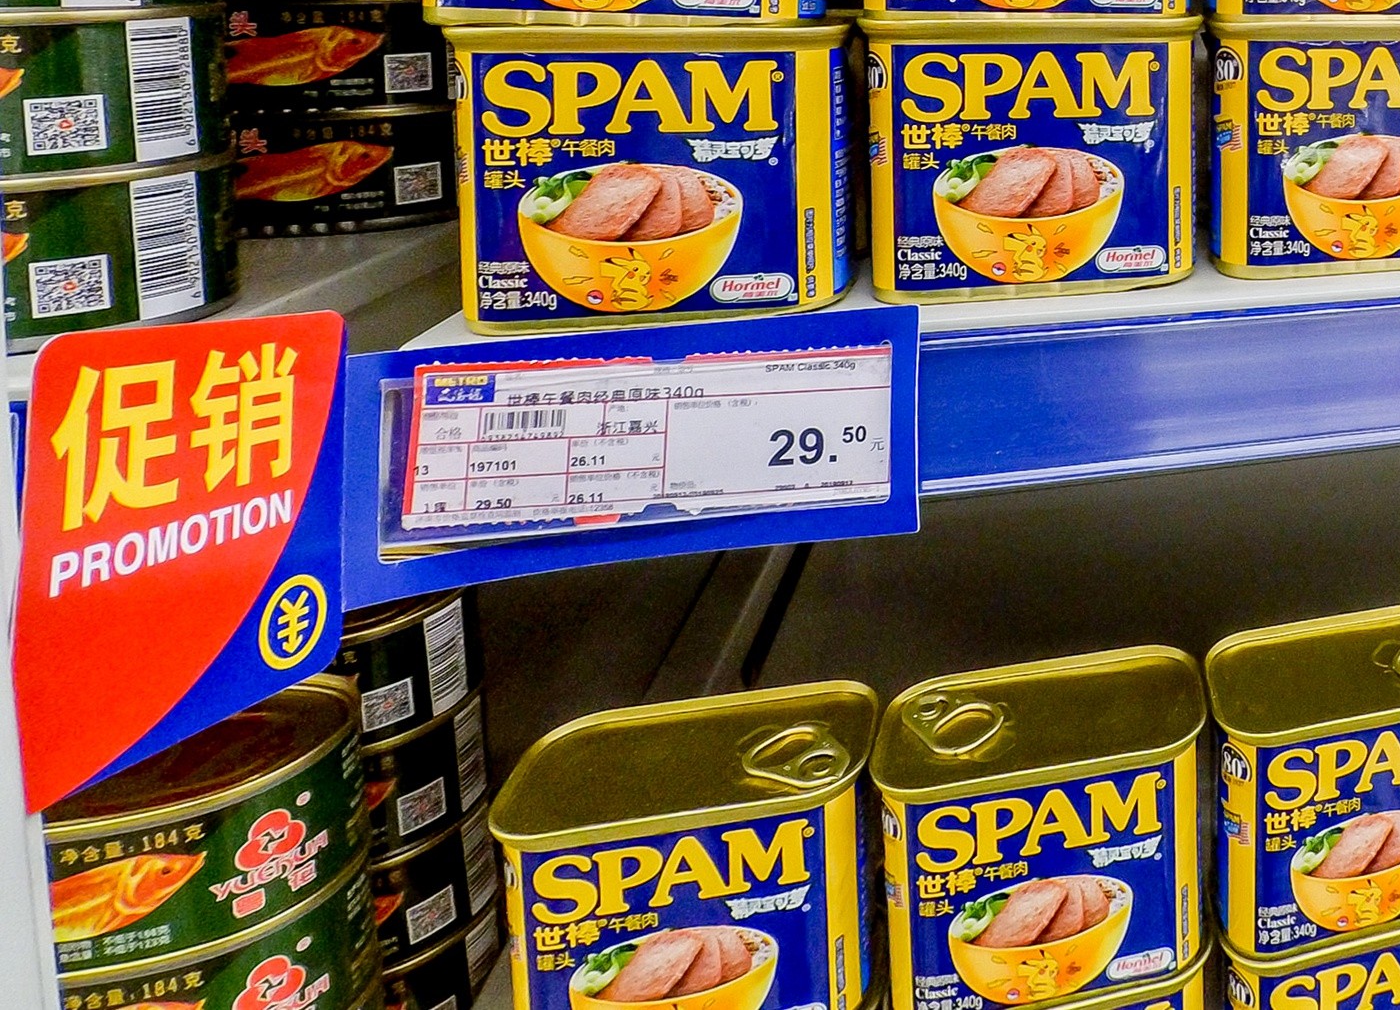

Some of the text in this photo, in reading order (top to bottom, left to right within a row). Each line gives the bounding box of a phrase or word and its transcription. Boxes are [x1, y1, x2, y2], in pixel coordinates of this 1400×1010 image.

[228, 11, 258, 37] 头
[0, 34, 22, 54] 克
[1216, 58, 1234, 81] 80
[901, 50, 1155, 123] SPAM
[481, 60, 778, 136] SPAM
[1256, 113, 1356, 136] 世棒 午餐肉
[239, 128, 267, 154] 头
[901, 123, 1017, 150] 世棒 午餐肉
[482, 139, 616, 167] 世棒 午餐肉
[1257, 140, 1290, 154] 罐头
[902, 152, 939, 170] 罐头
[483, 171, 526, 190] 罐头
[4, 199, 27, 220] 克
[1250, 227, 1290, 239] Classic
[897, 249, 942, 261] Classic
[1106, 251, 1155, 263] Hormel
[478, 275, 528, 289] Classic
[722, 278, 781, 292] Hormel
[765, 361, 856, 373] SPAM Classic 340g
[50, 342, 298, 533] 促销
[435, 427, 462, 440] 合格
[596, 420, 658, 436] 浙江嘉兴
[768, 426, 885, 467] 29.50 元
[414, 456, 606, 476] 13 197101 26.11
[476, 493, 604, 510] 29.50 26.11
[48, 490, 292, 600] PROMOTION
[1223, 757, 1242, 777] 80
[915, 772, 1162, 873] SPAM
[1265, 800, 1362, 835] 世棒 午餐肉
[183, 823, 206, 843] 克
[1265, 836, 1297, 852] 罐头
[531, 818, 811, 924] SPAM
[916, 861, 1029, 900] 世棒 午餐肉
[918, 903, 954, 918] 罐头
[1257, 914, 1296, 928] Classic
[533, 912, 659, 952] 世棒 午餐肉
[182, 970, 205, 988] 克
